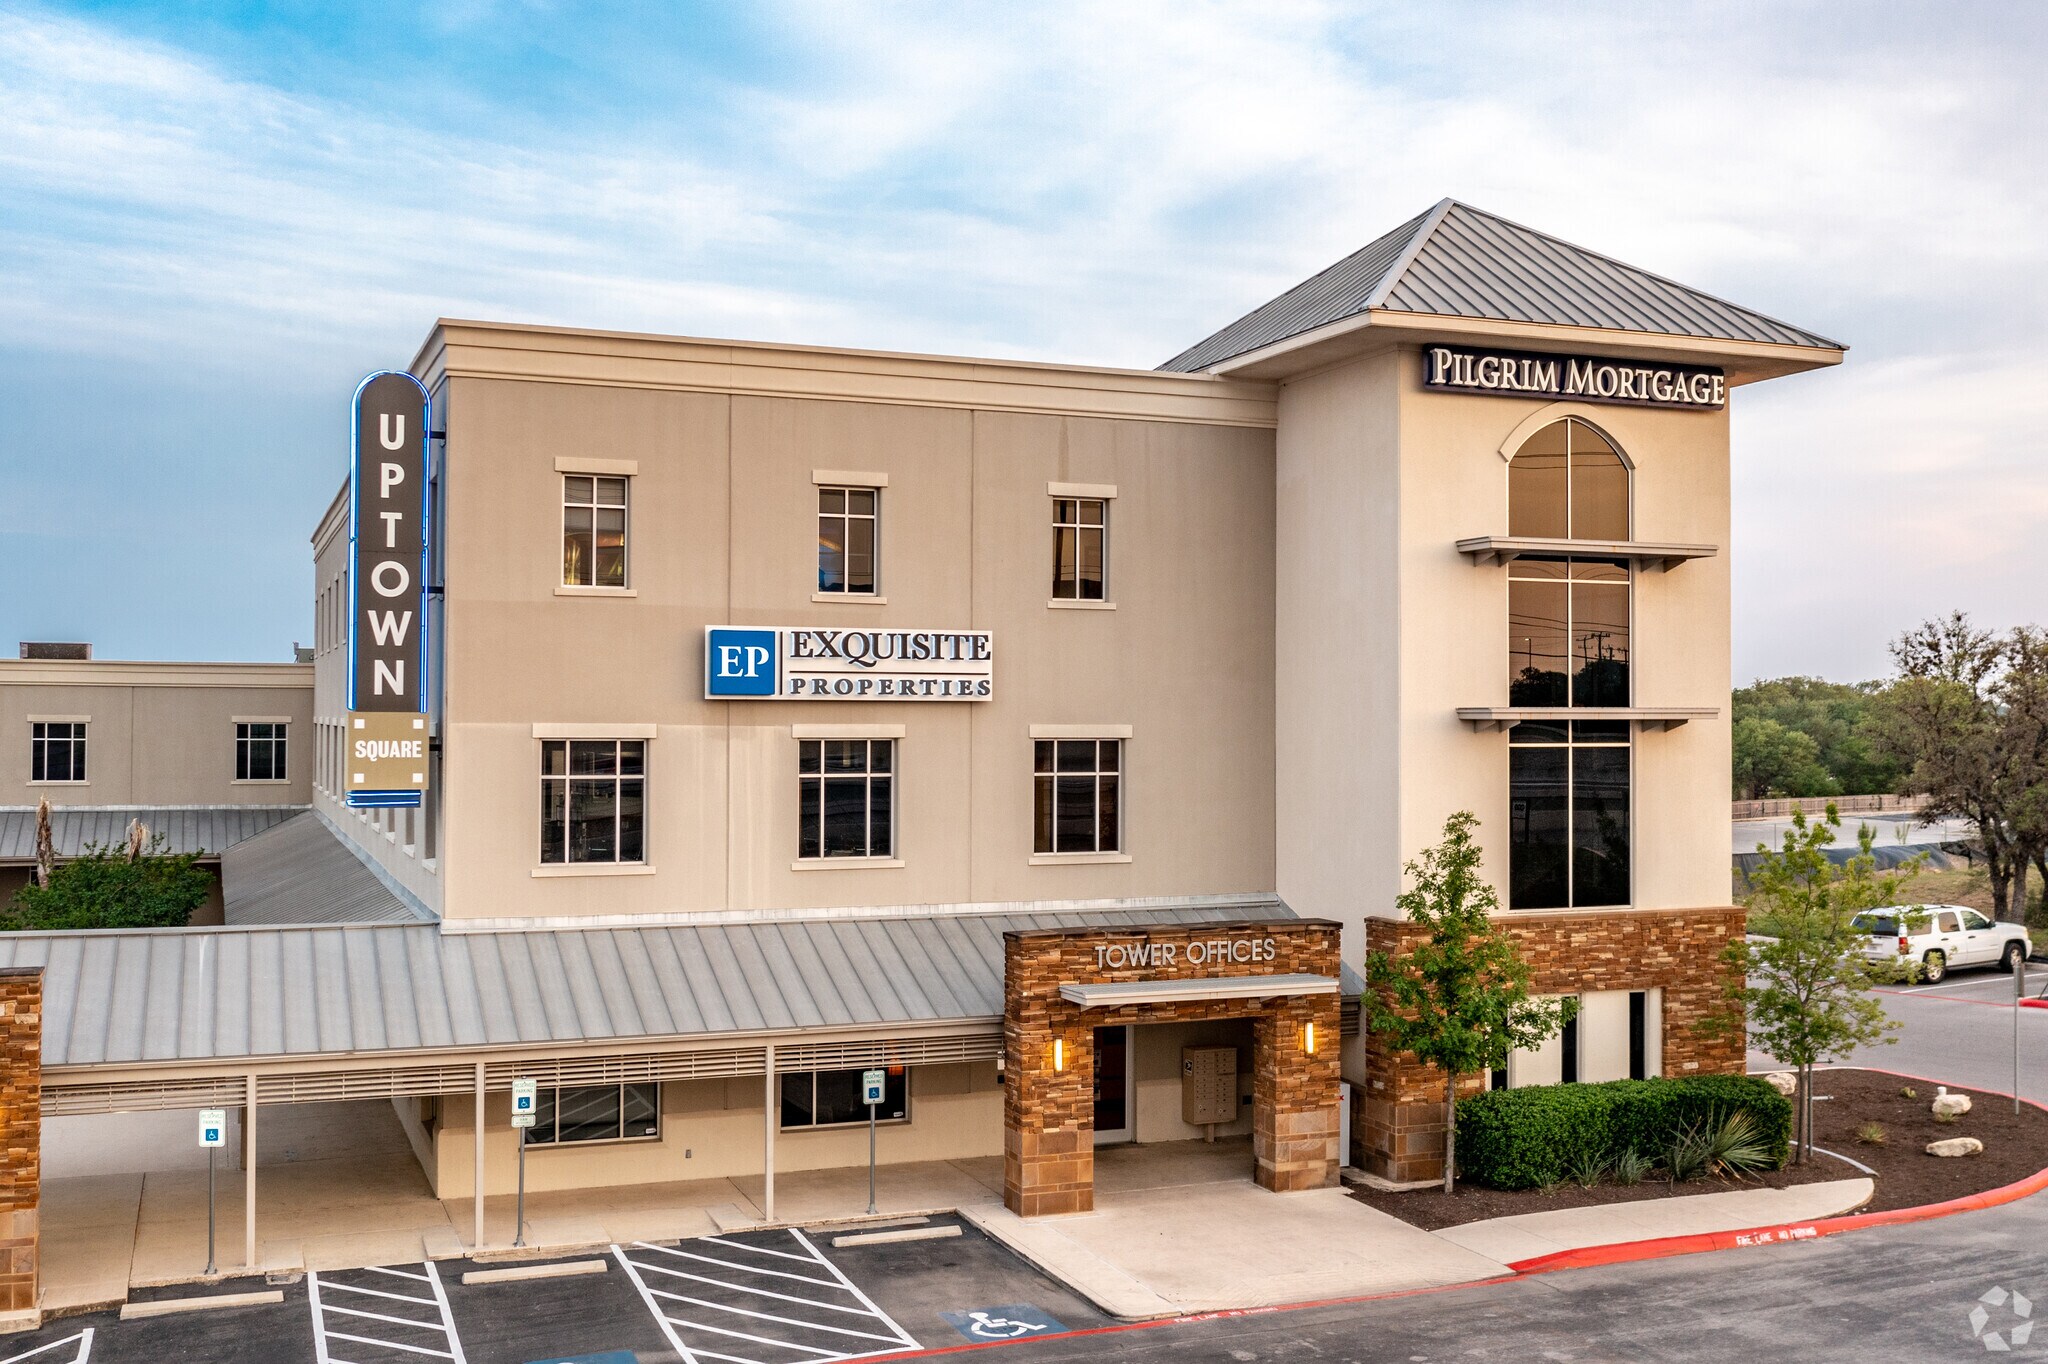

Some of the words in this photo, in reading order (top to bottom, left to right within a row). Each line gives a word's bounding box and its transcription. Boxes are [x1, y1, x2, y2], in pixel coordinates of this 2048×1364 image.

[1430, 348, 1560, 393] PILGRIM
[1564, 359, 1725, 405] MORTGAGE
[367, 413, 413, 697] UPTOWN
[717, 645, 770, 678] EP
[790, 631, 991, 668] EXQUISITE
[789, 678, 991, 696] PROPERTIES
[355, 740, 422, 762] SQUARE
[1094, 942, 1176, 969] TOWER
[1186, 938, 1276, 964] OFFICES
